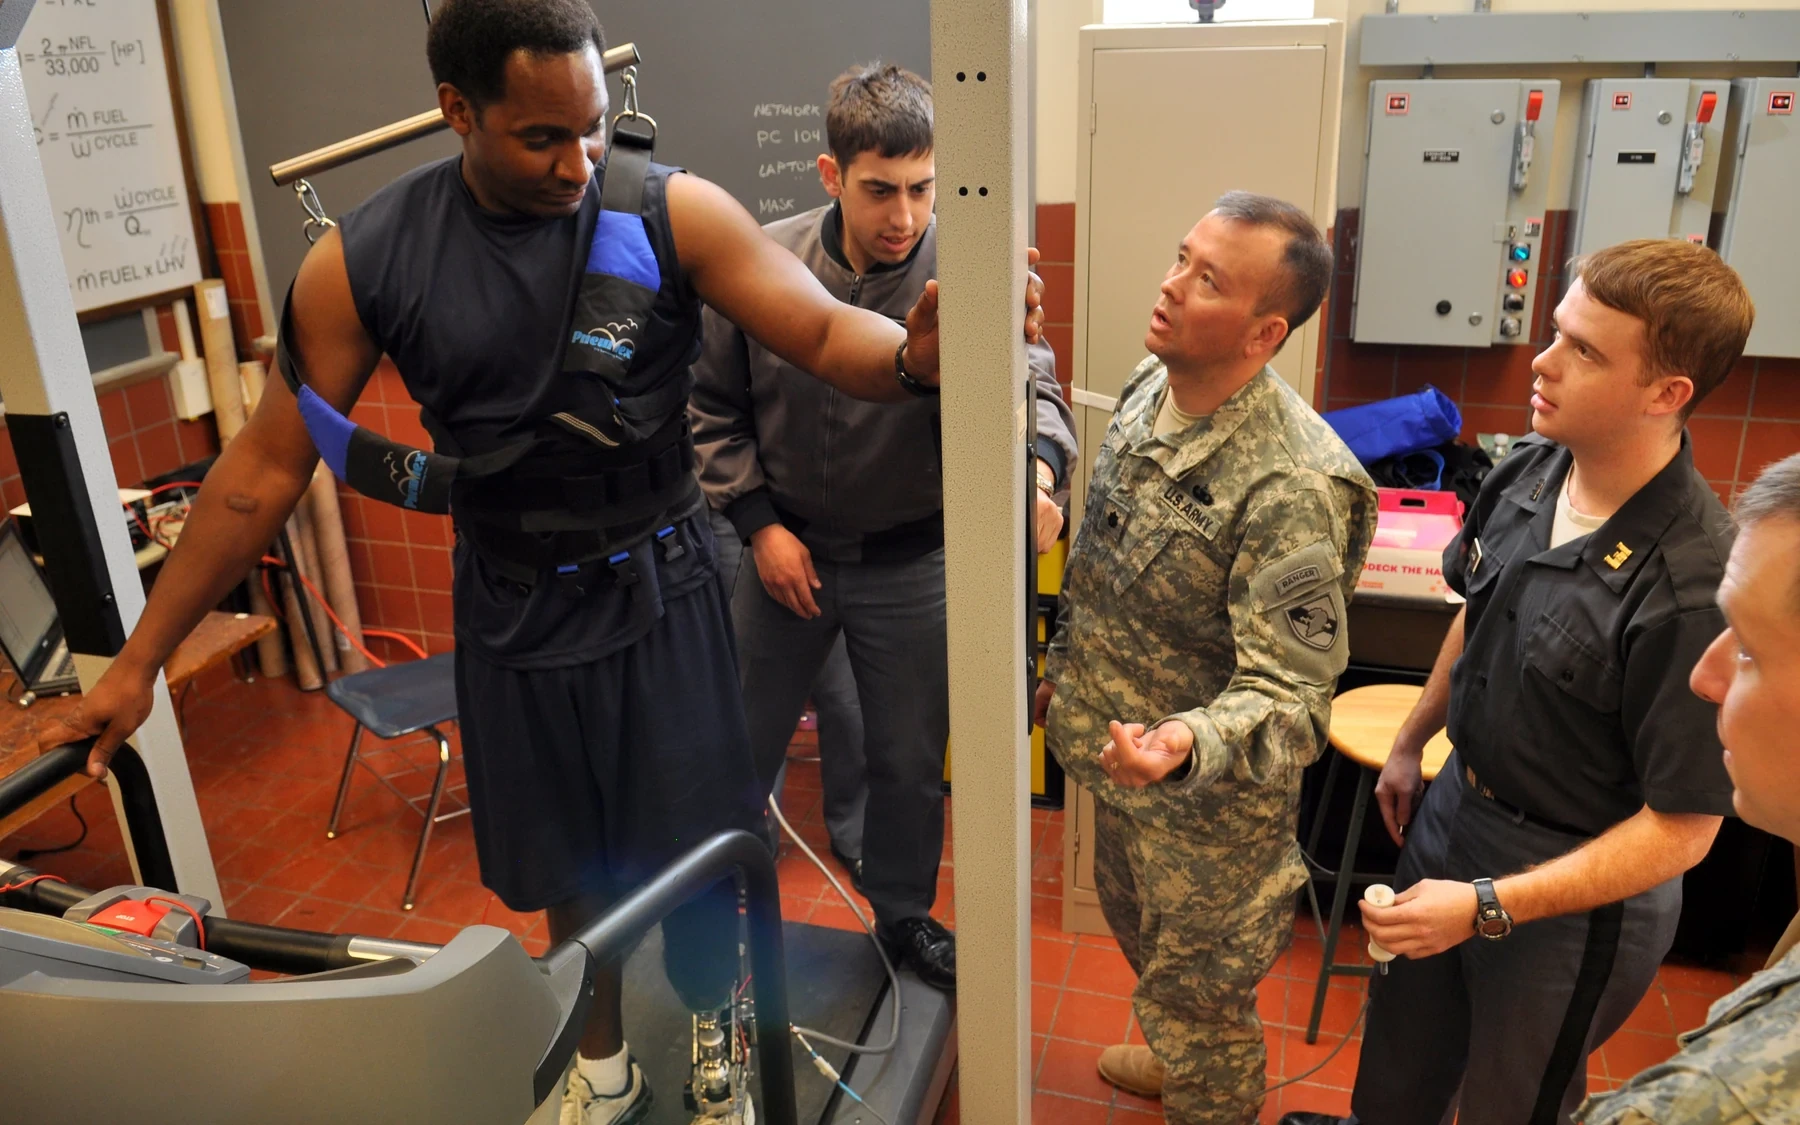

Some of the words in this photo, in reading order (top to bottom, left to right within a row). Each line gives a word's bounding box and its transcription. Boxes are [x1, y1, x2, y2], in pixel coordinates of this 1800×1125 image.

[45, 56, 99, 77] 33,000
[93, 109, 128, 125] FUEL
[754, 103, 820, 118] NETWORK
[94, 132, 138, 150] CYCLE
[757, 129, 782, 148] PC
[794, 128, 821, 144] 104
[758, 160, 817, 178] LAPTOP
[759, 198, 795, 214] MASK
[1368, 563, 1398, 573] DECK
[1402, 566, 1421, 575] THE
[1425, 568, 1443, 577] HA
[1282, 569, 1316, 589] RANGER
[115, 914, 136, 922] STOP
